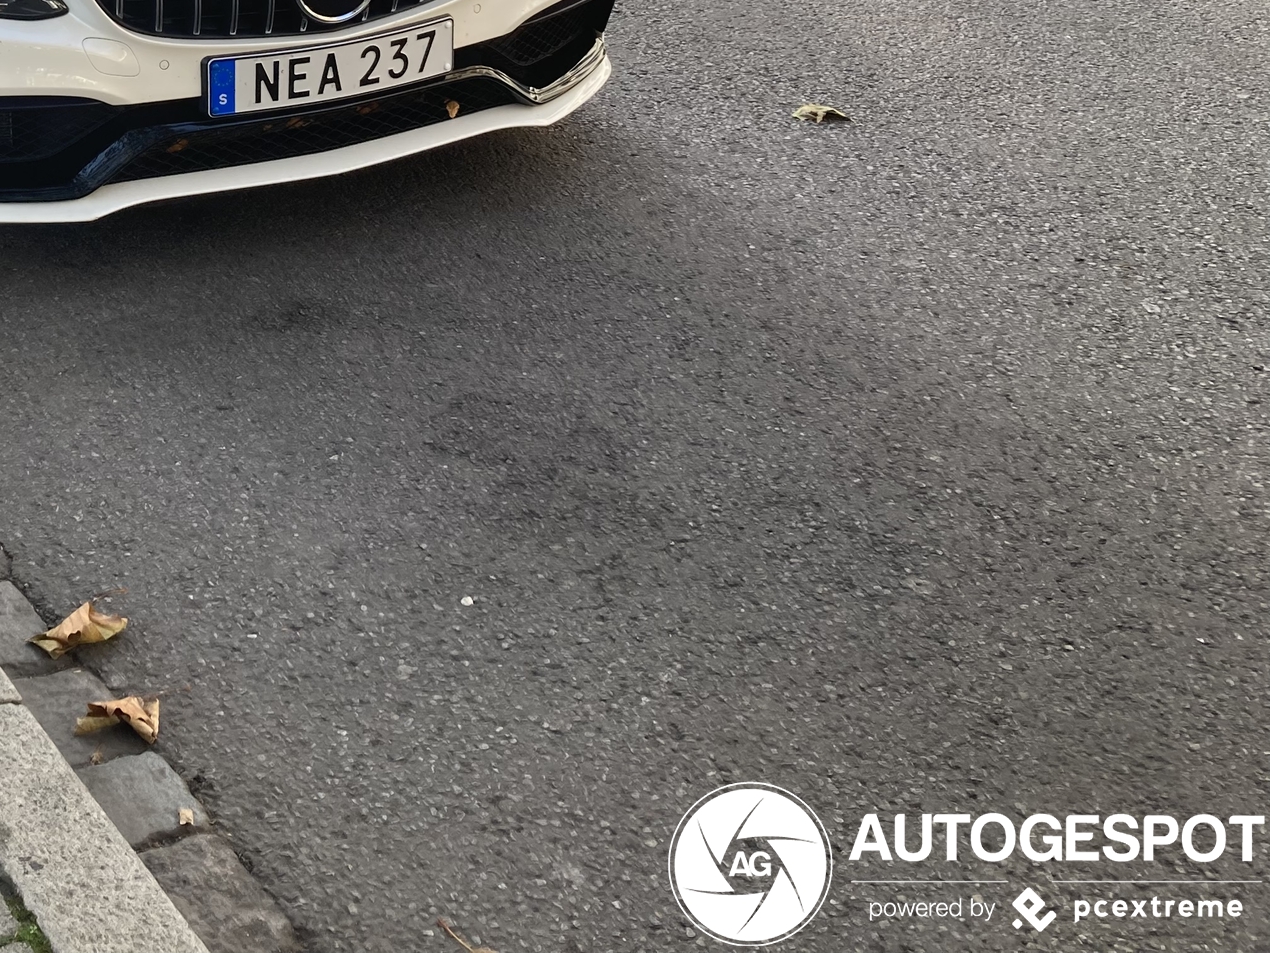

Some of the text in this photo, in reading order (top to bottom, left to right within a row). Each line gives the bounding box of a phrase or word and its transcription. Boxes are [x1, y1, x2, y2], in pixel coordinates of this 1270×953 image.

[254, 29, 436, 104] NEA 237
[218, 94, 228, 106] S
